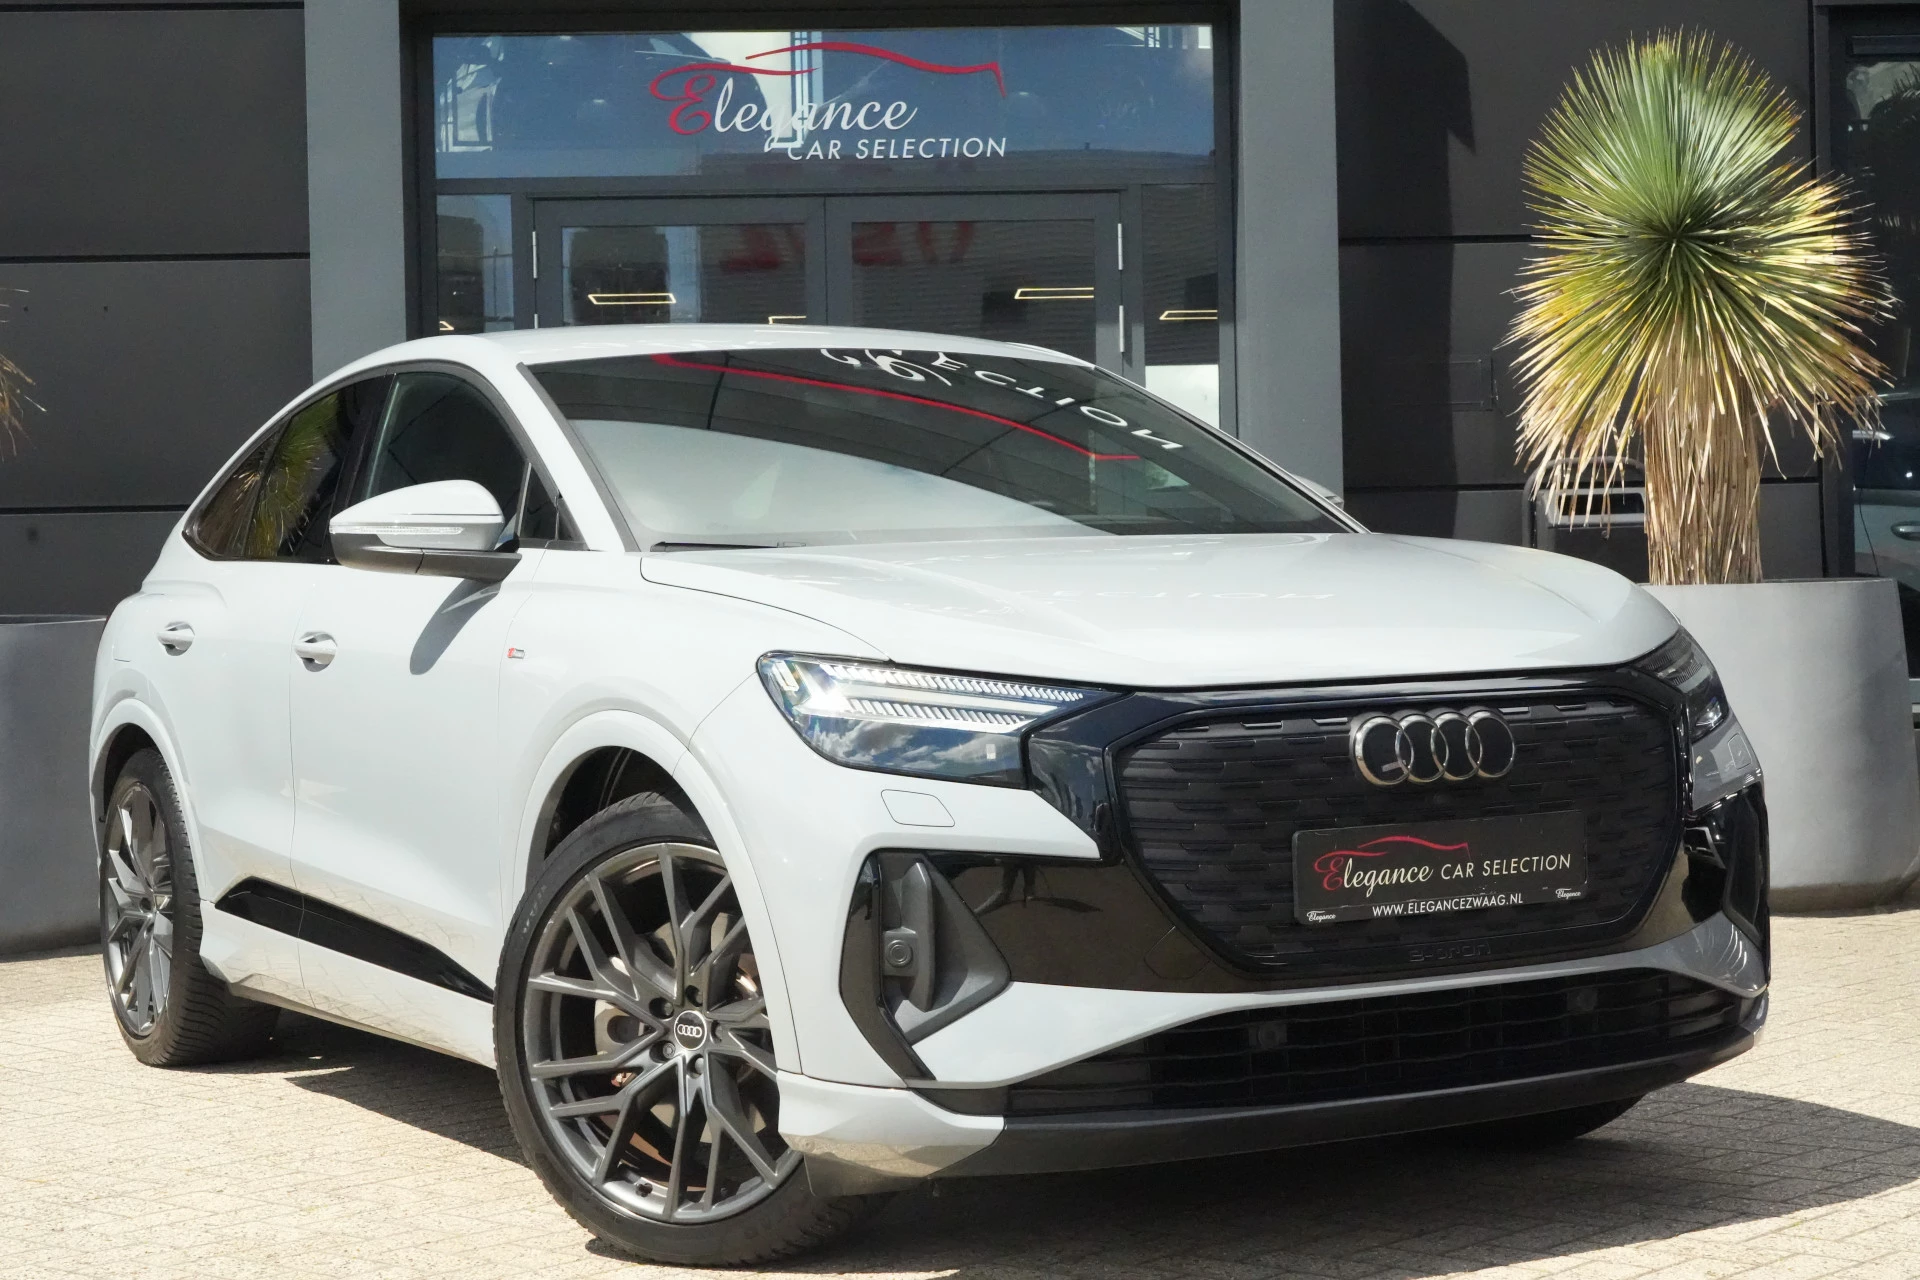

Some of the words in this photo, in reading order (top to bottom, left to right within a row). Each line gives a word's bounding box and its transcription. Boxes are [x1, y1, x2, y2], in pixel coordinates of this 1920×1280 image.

[649, 62, 918, 153] Elegance
[787, 139, 841, 161] CAR
[855, 137, 1007, 159] SELECTION
[1313, 850, 1433, 898] Elegance
[1441, 862, 1474, 881] CAR
[1482, 853, 1572, 877] SELECTION
[1372, 892, 1524, 918] WWW.ELEGANCEZWAAG.NL
